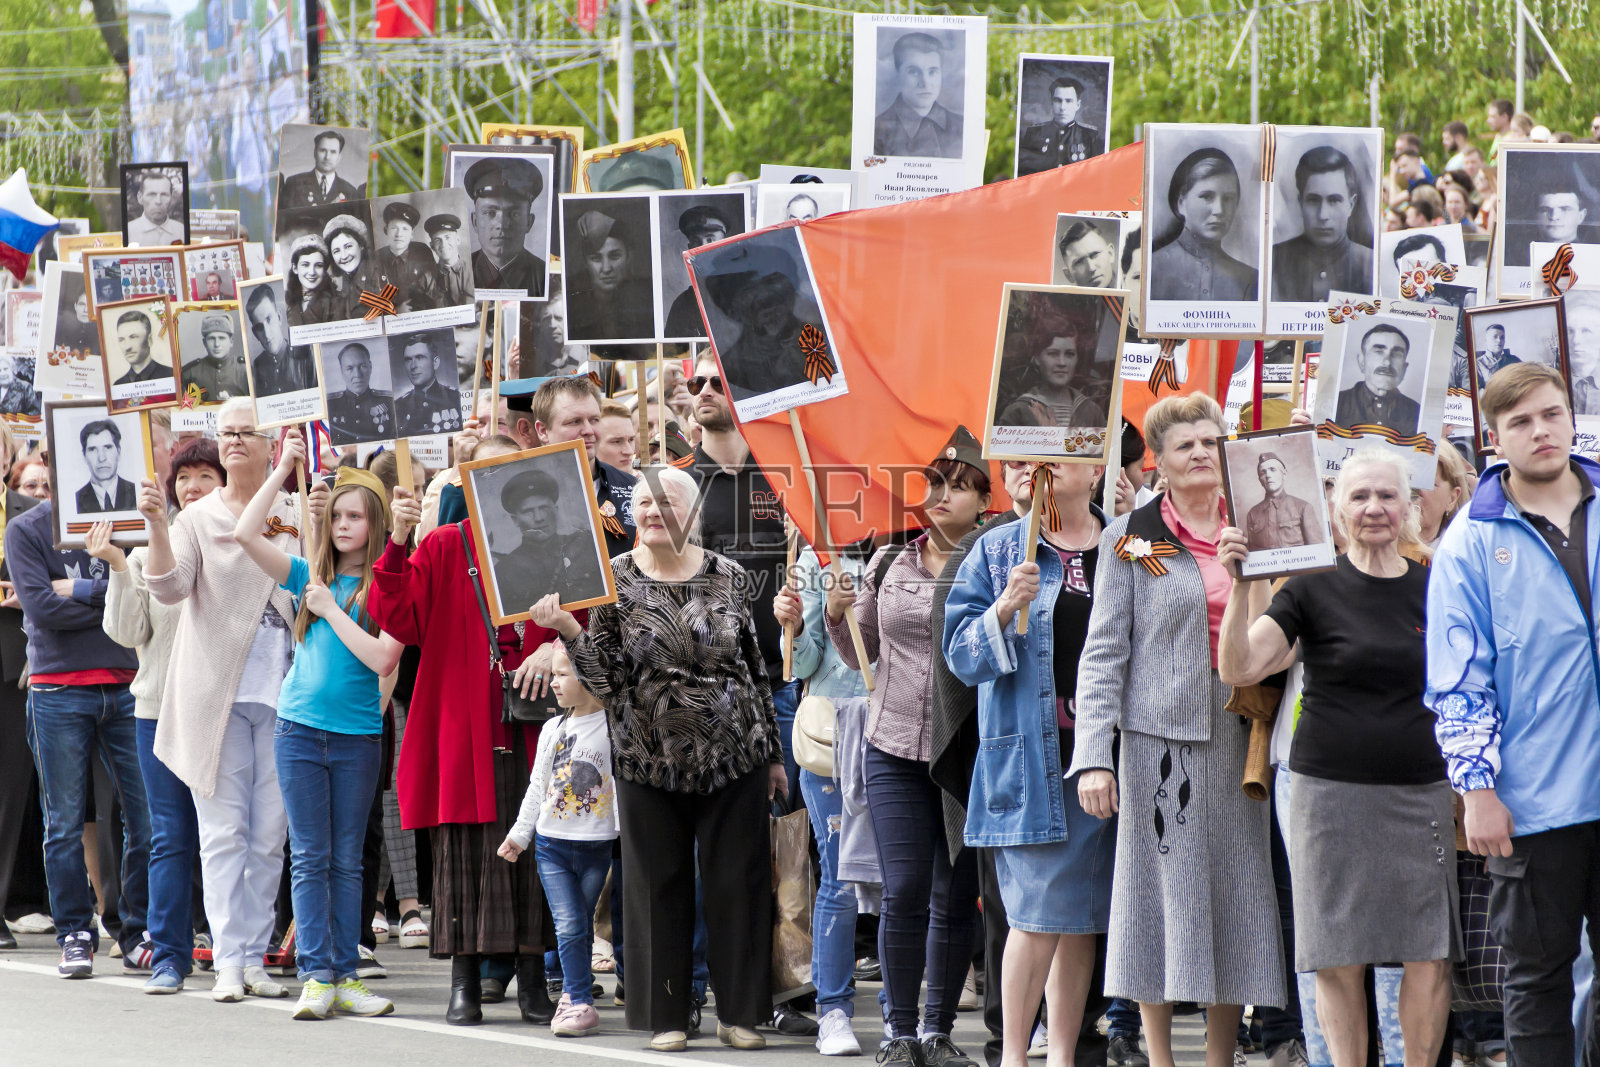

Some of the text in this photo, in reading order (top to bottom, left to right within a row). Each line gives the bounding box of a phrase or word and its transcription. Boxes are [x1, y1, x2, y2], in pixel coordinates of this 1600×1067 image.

[871, 15, 933, 23] БЕССМЕРТНЫЙ
[896, 172, 938, 181] Пономарев
[884, 184, 950, 193] Иван Яковлевич
[1182, 311, 1231, 319] ФОМИНА
[1157, 321, 1257, 329] АЛЕКСАНДРА ГРИГОРЬЕВНА
[1282, 322, 1308, 331] ПЕТР
[1248, 555, 1317, 568] НИКОЛАЙ АНДРЕЕВИЧ
[576, 747, 604, 769] Fluffy
